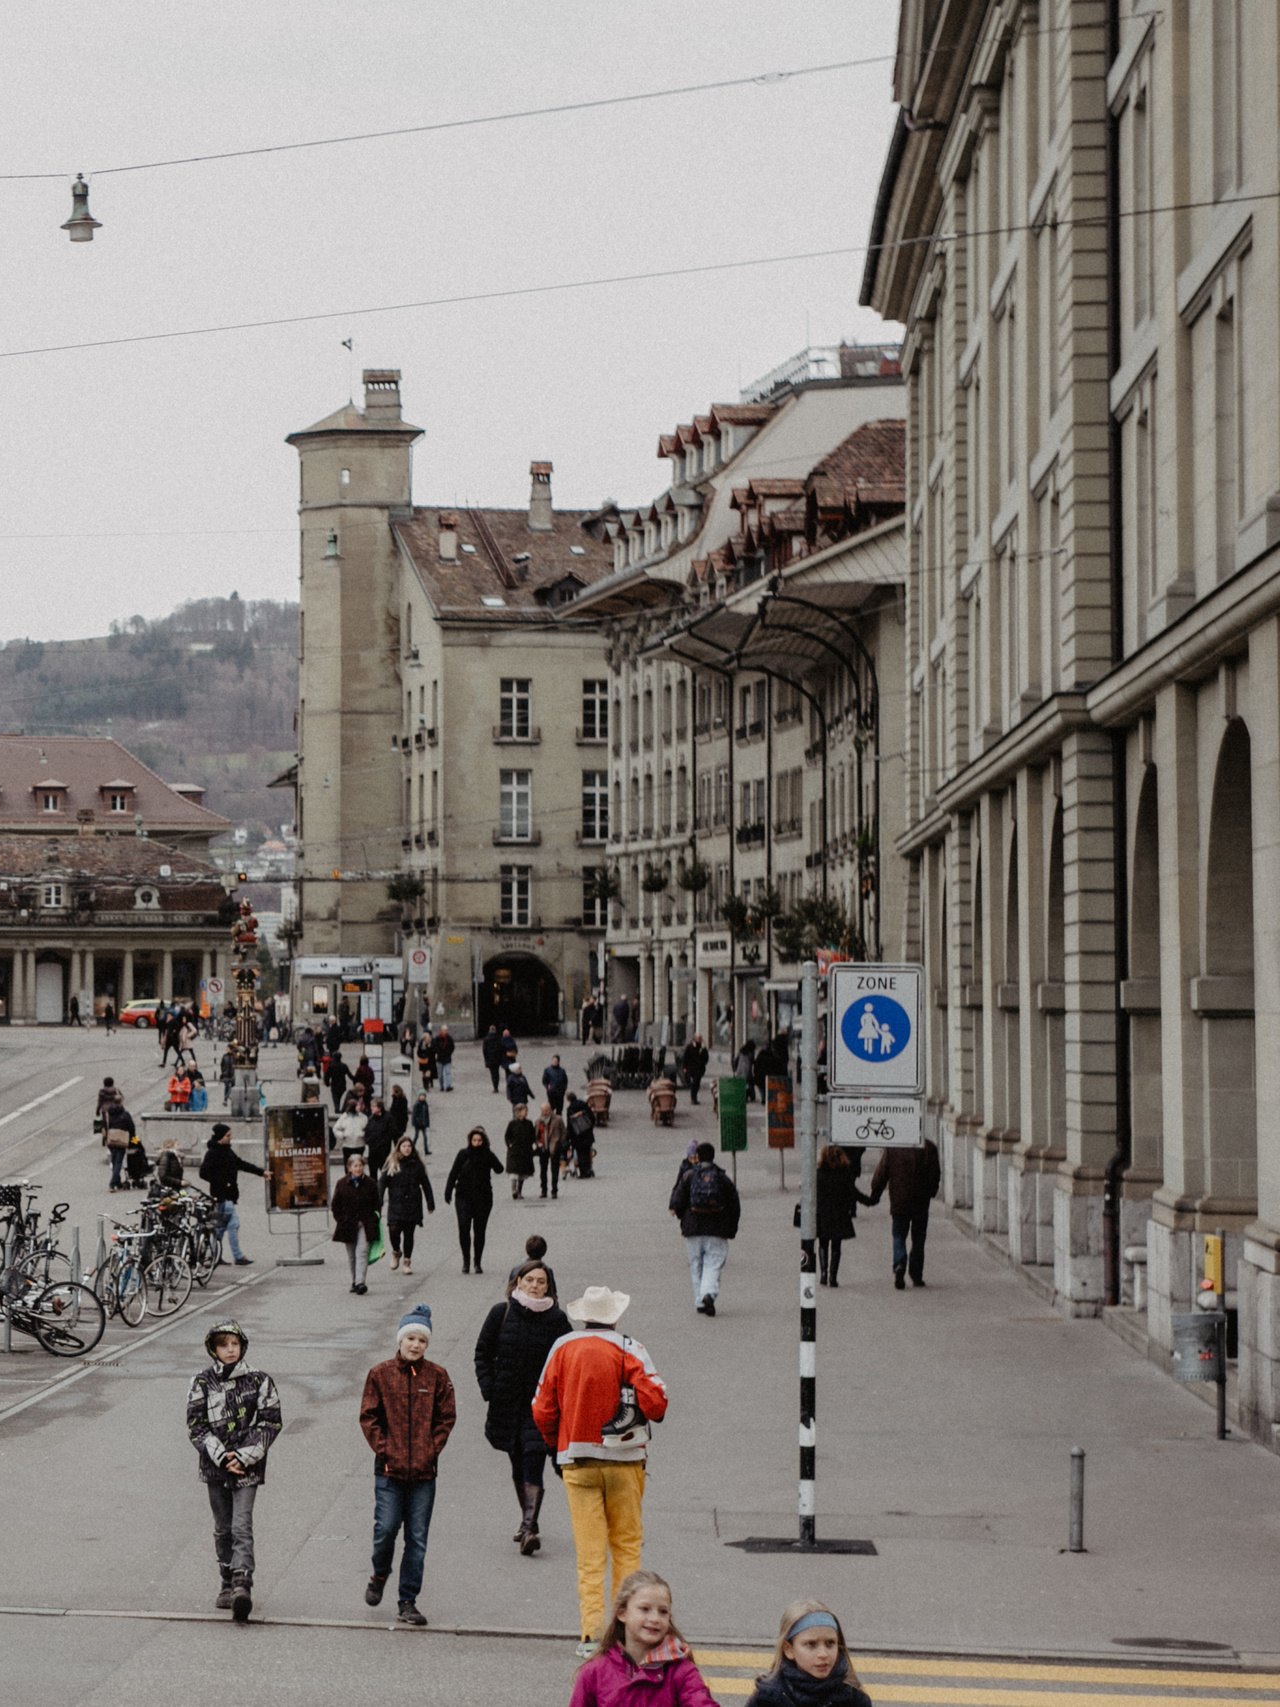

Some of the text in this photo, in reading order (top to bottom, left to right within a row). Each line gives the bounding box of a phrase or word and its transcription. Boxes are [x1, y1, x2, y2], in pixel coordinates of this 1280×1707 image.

[857, 977, 897, 990] ZONE
[838, 1104, 914, 1116] ausgenommen
[274, 1147, 322, 1158] BELSHAZZAR
